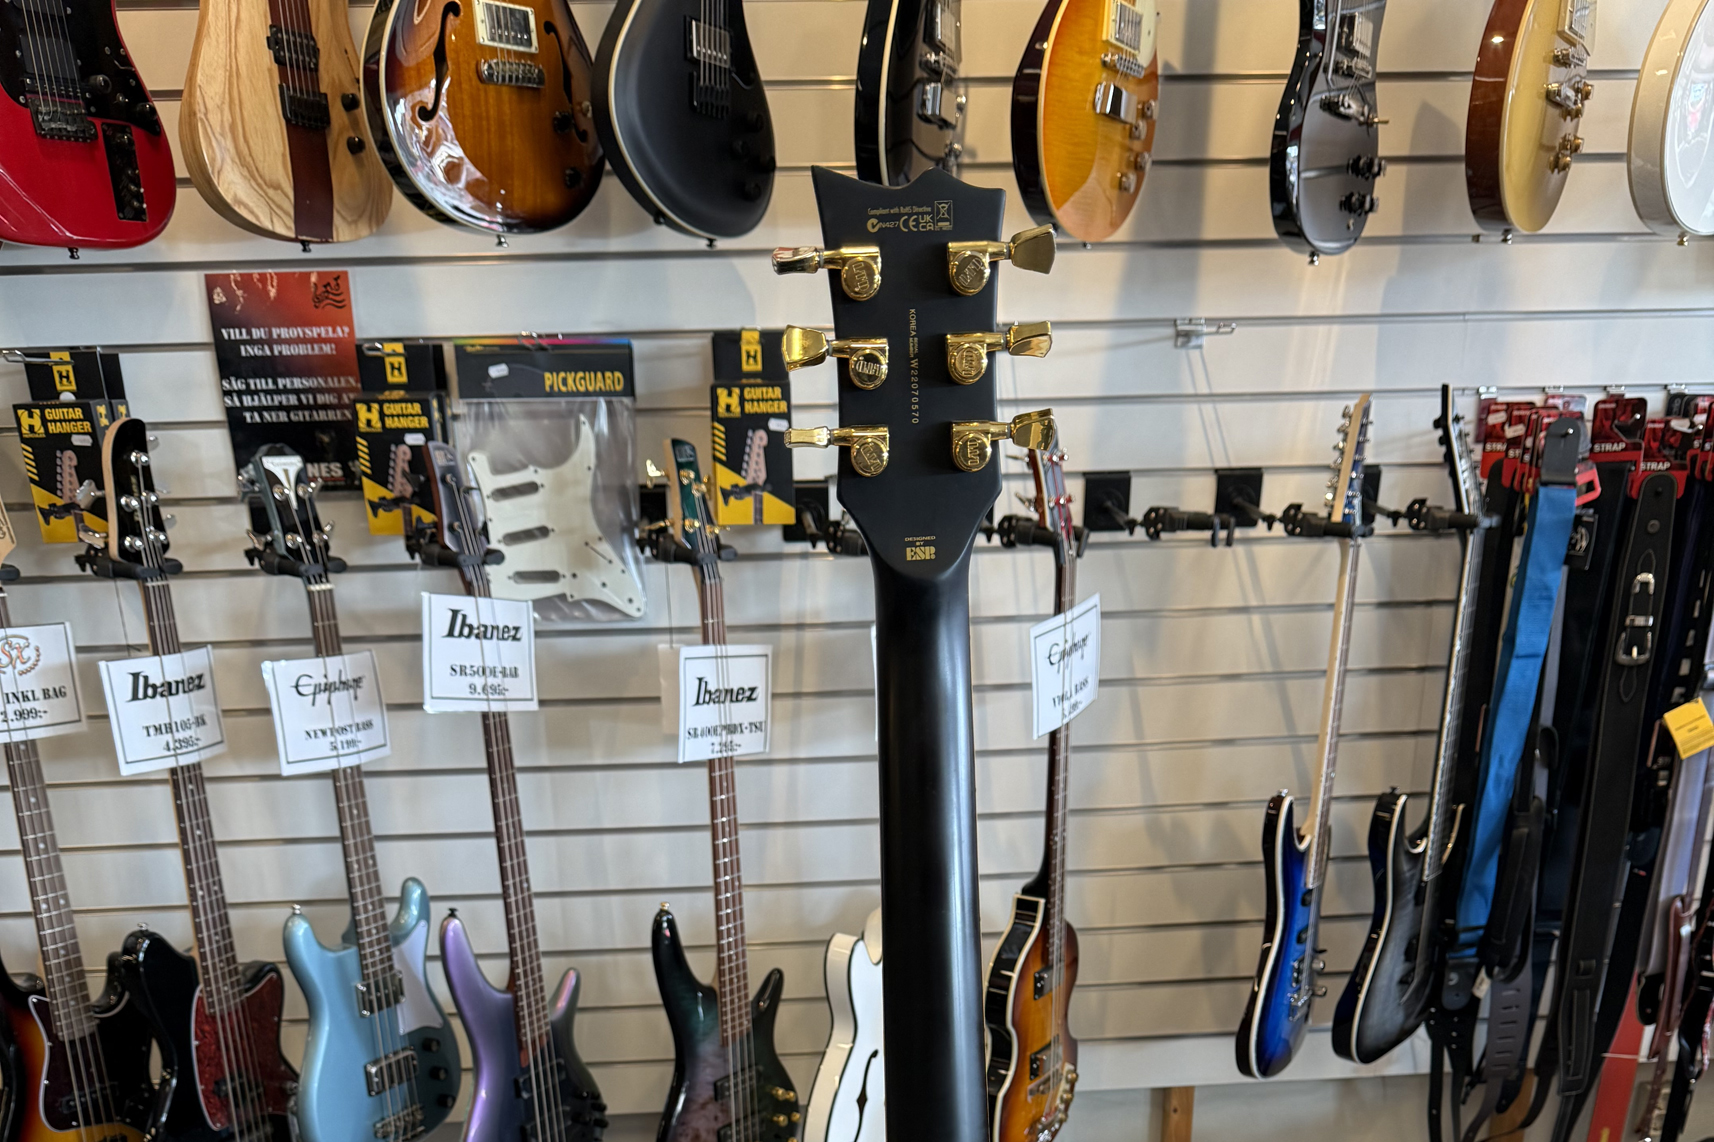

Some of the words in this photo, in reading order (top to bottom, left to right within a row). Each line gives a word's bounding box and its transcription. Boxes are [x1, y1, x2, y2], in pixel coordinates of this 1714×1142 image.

[909, 308, 917, 337] KOREA
[221, 327, 250, 340] VILL
[251, 327, 269, 339] DU
[271, 325, 350, 339] PROVSPELA?
[240, 344, 271, 357] INGA
[272, 342, 336, 356] PROBLEM!
[222, 376, 246, 391] SÄG
[247, 376, 276, 390] TILL
[276, 374, 361, 390] PERSONALEN,
[543, 370, 624, 393] PICKGUARD
[743, 386, 782, 400] GUITAR
[910, 358, 920, 424] W22070570
[223, 394, 241, 408] SÅ
[242, 392, 298, 407] HJÄLPER
[300, 393, 315, 405] VI
[315, 392, 338, 405] DIG
[744, 400, 788, 414] HANGER
[44, 407, 84, 420] GUITAR
[243, 410, 262, 424] TA
[262, 409, 289, 422] NER
[289, 407, 353, 422] GITARREN
[382, 402, 422, 416] GUITAR
[47, 421, 92, 434] HANGER
[384, 416, 429, 429] HANGER
[1593, 441, 1626, 453] STRAP
[1640, 461, 1671, 471] STRAP
[441, 608, 523, 642] Ibanez
[1045, 631, 1091, 675] Epiphone
[5, 690, 40, 704] INKL
[41, 685, 67, 700] BAG
[125, 671, 206, 703] Ibanez
[290, 669, 366, 706] Epiphone
[691, 676, 759, 707] Ibanez
